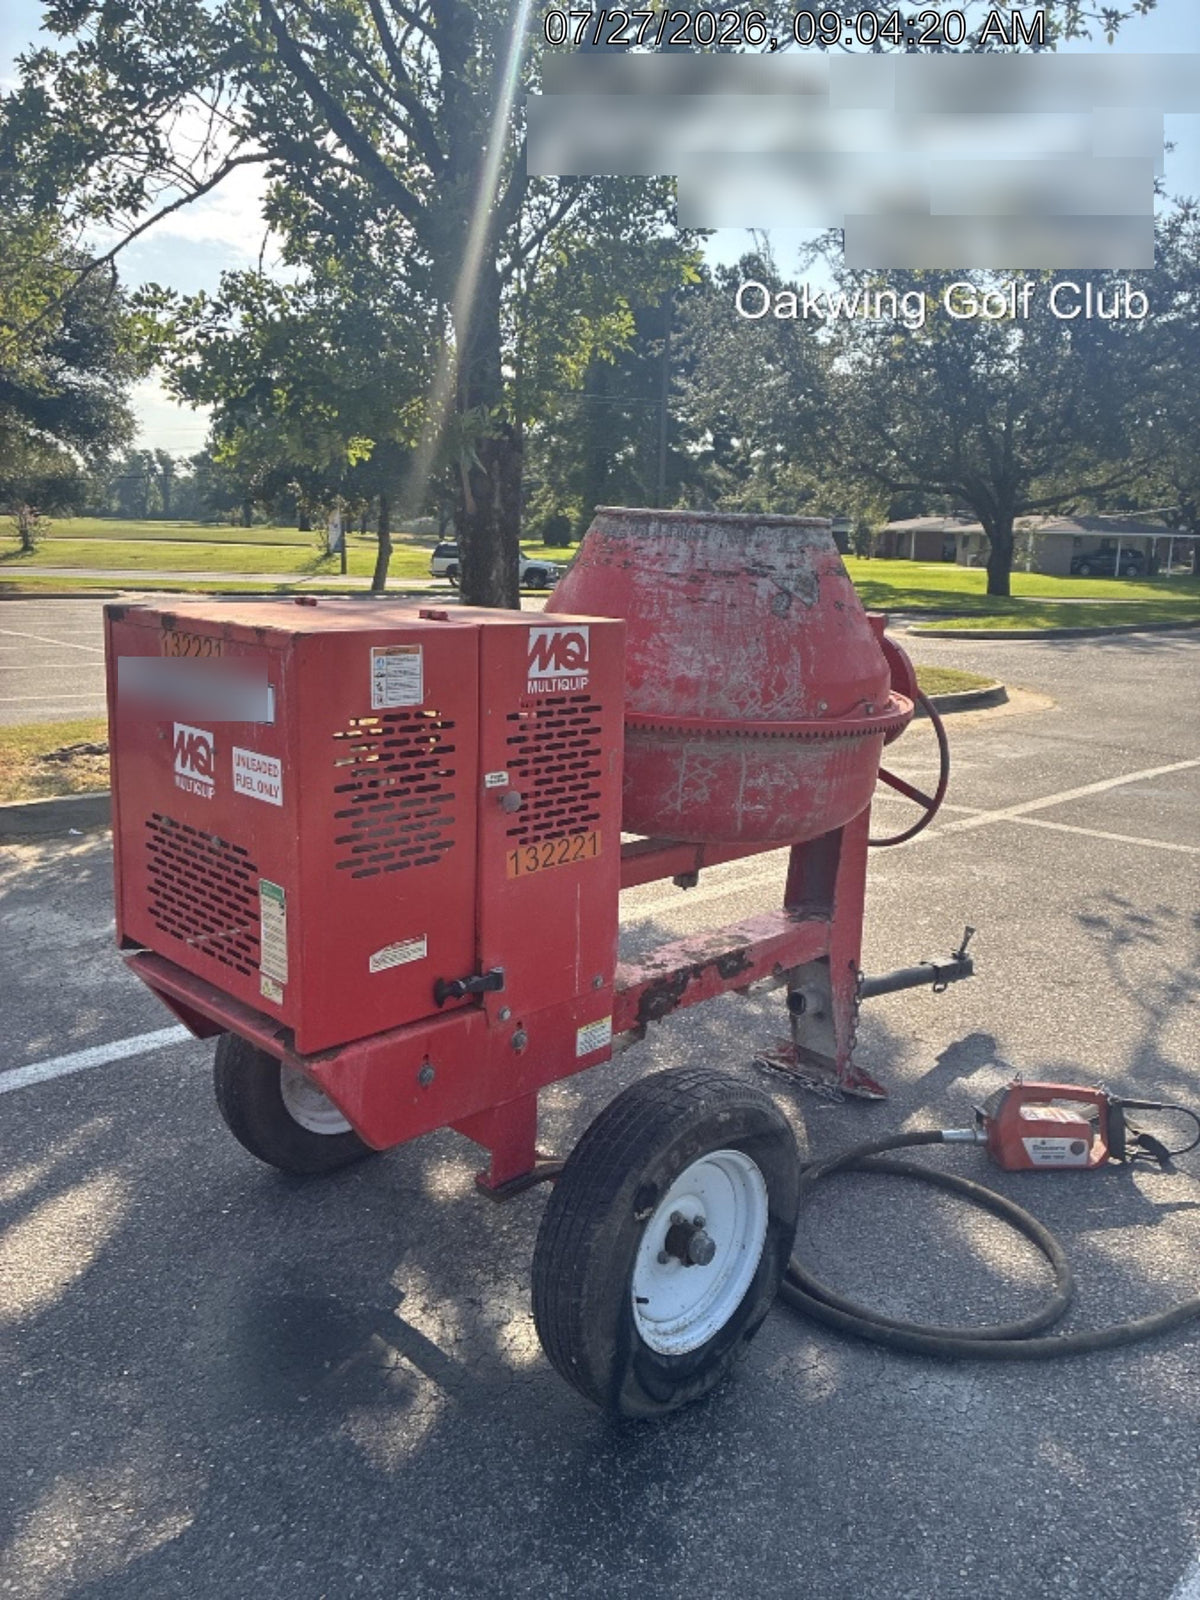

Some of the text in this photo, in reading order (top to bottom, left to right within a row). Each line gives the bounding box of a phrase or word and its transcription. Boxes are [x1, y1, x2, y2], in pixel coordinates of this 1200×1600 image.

[527, 632, 588, 672] MQ
[527, 677, 589, 694] MULTIQUIP
[235, 753, 280, 778] UNLEADED
[235, 773, 280, 798] FUEL ONLY
[509, 832, 597, 876] 132221
